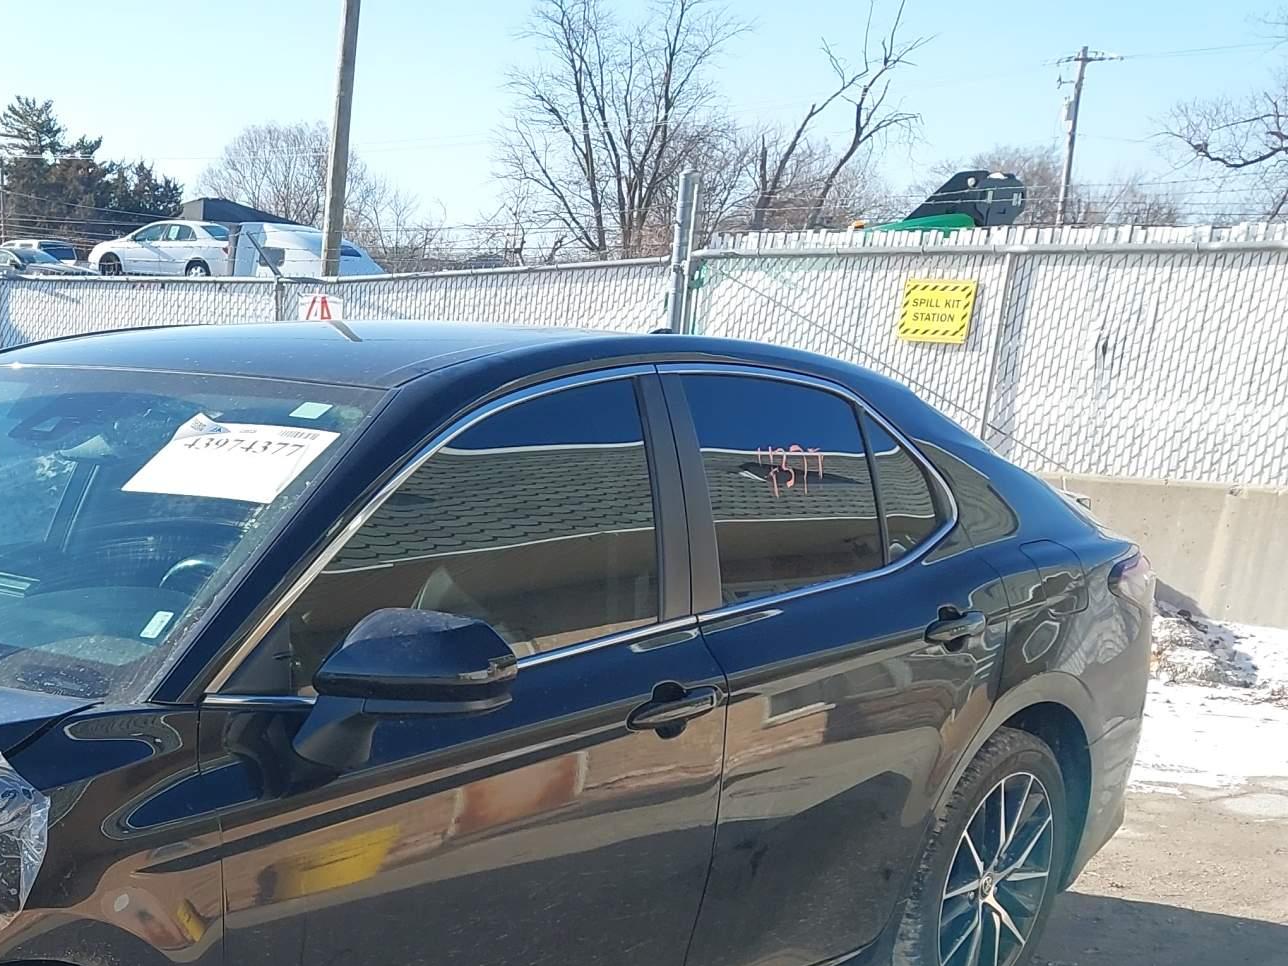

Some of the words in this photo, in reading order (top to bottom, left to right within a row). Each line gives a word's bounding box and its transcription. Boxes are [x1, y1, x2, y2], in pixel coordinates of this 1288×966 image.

[912, 298, 940, 308] SPILL
[944, 299, 962, 309] KIT
[912, 312, 955, 323] STATION
[184, 437, 305, 457] 43974377
